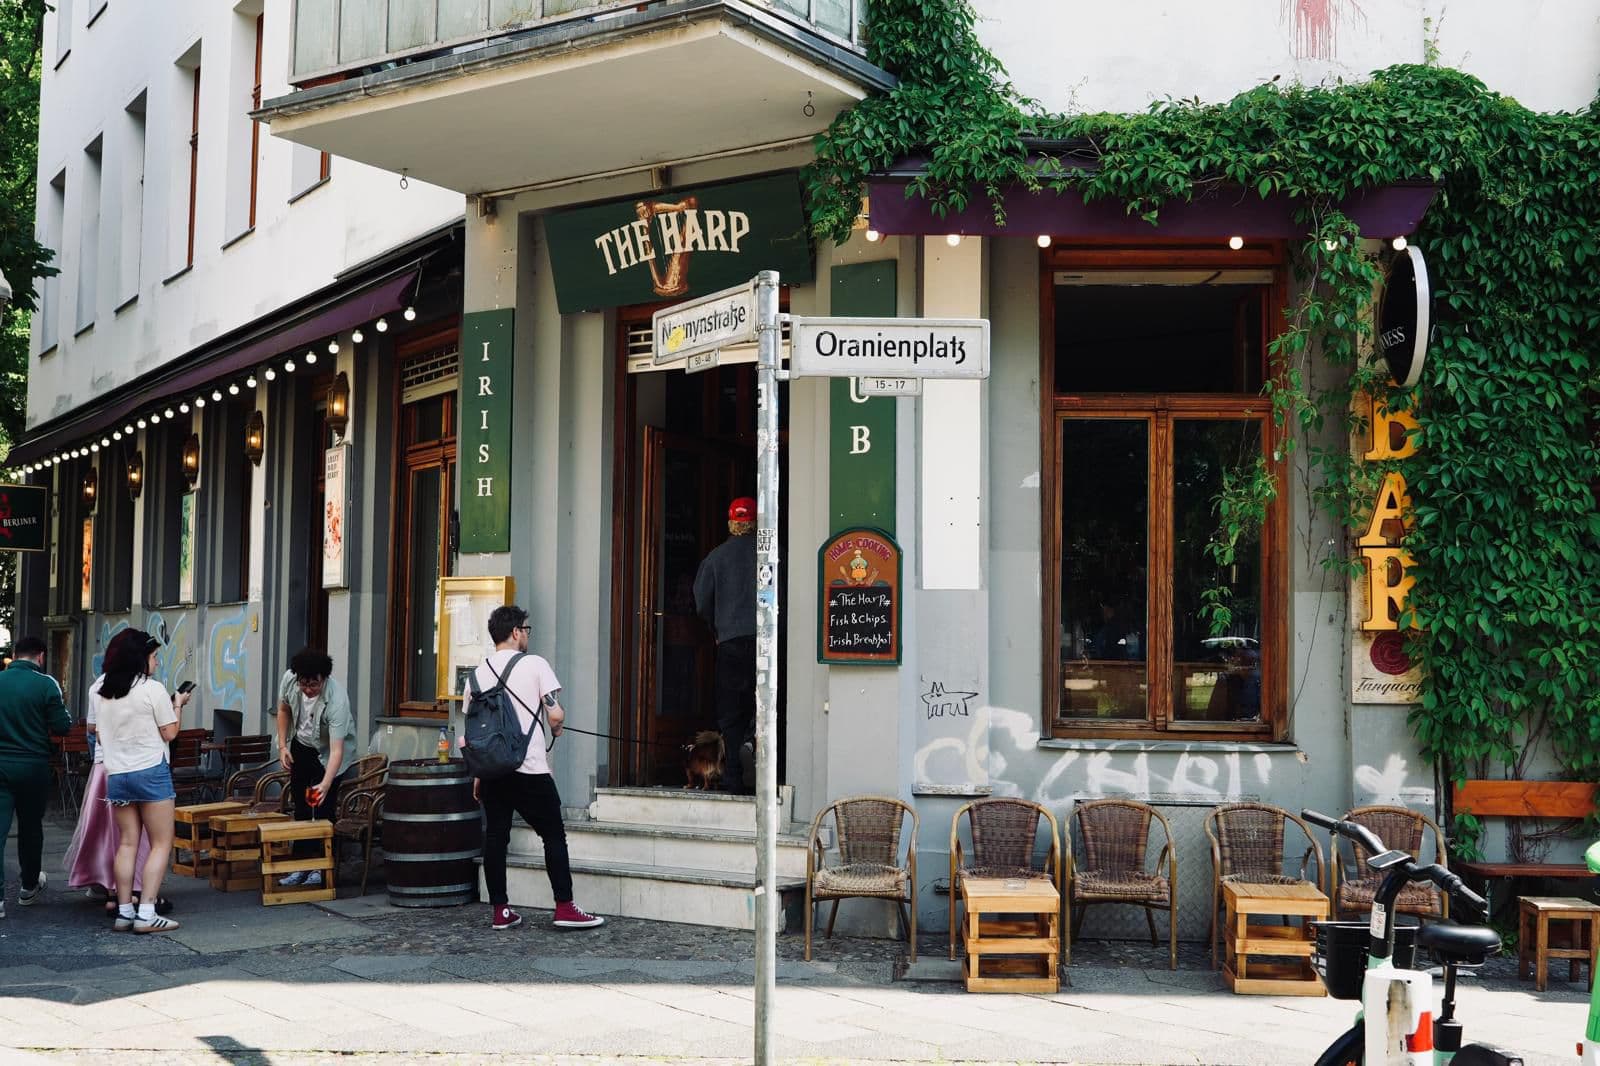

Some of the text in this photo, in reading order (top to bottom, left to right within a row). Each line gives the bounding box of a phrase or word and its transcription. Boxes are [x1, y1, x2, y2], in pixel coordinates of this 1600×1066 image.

[595, 209, 750, 275] THE HARP
[662, 300, 746, 345] Nnynstraße
[815, 331, 966, 364] Oranienplatz
[875, 380, 886, 389] 15
[895, 380, 905, 389] 17
[476, 342, 494, 497] IRISH
[3, 516, 37, 527] BERLINER
[829, 538, 891, 561] HOME COOKING
[830, 614, 849, 627] Fish
[851, 612, 858, 624] &
[829, 632, 852, 647] Irish
